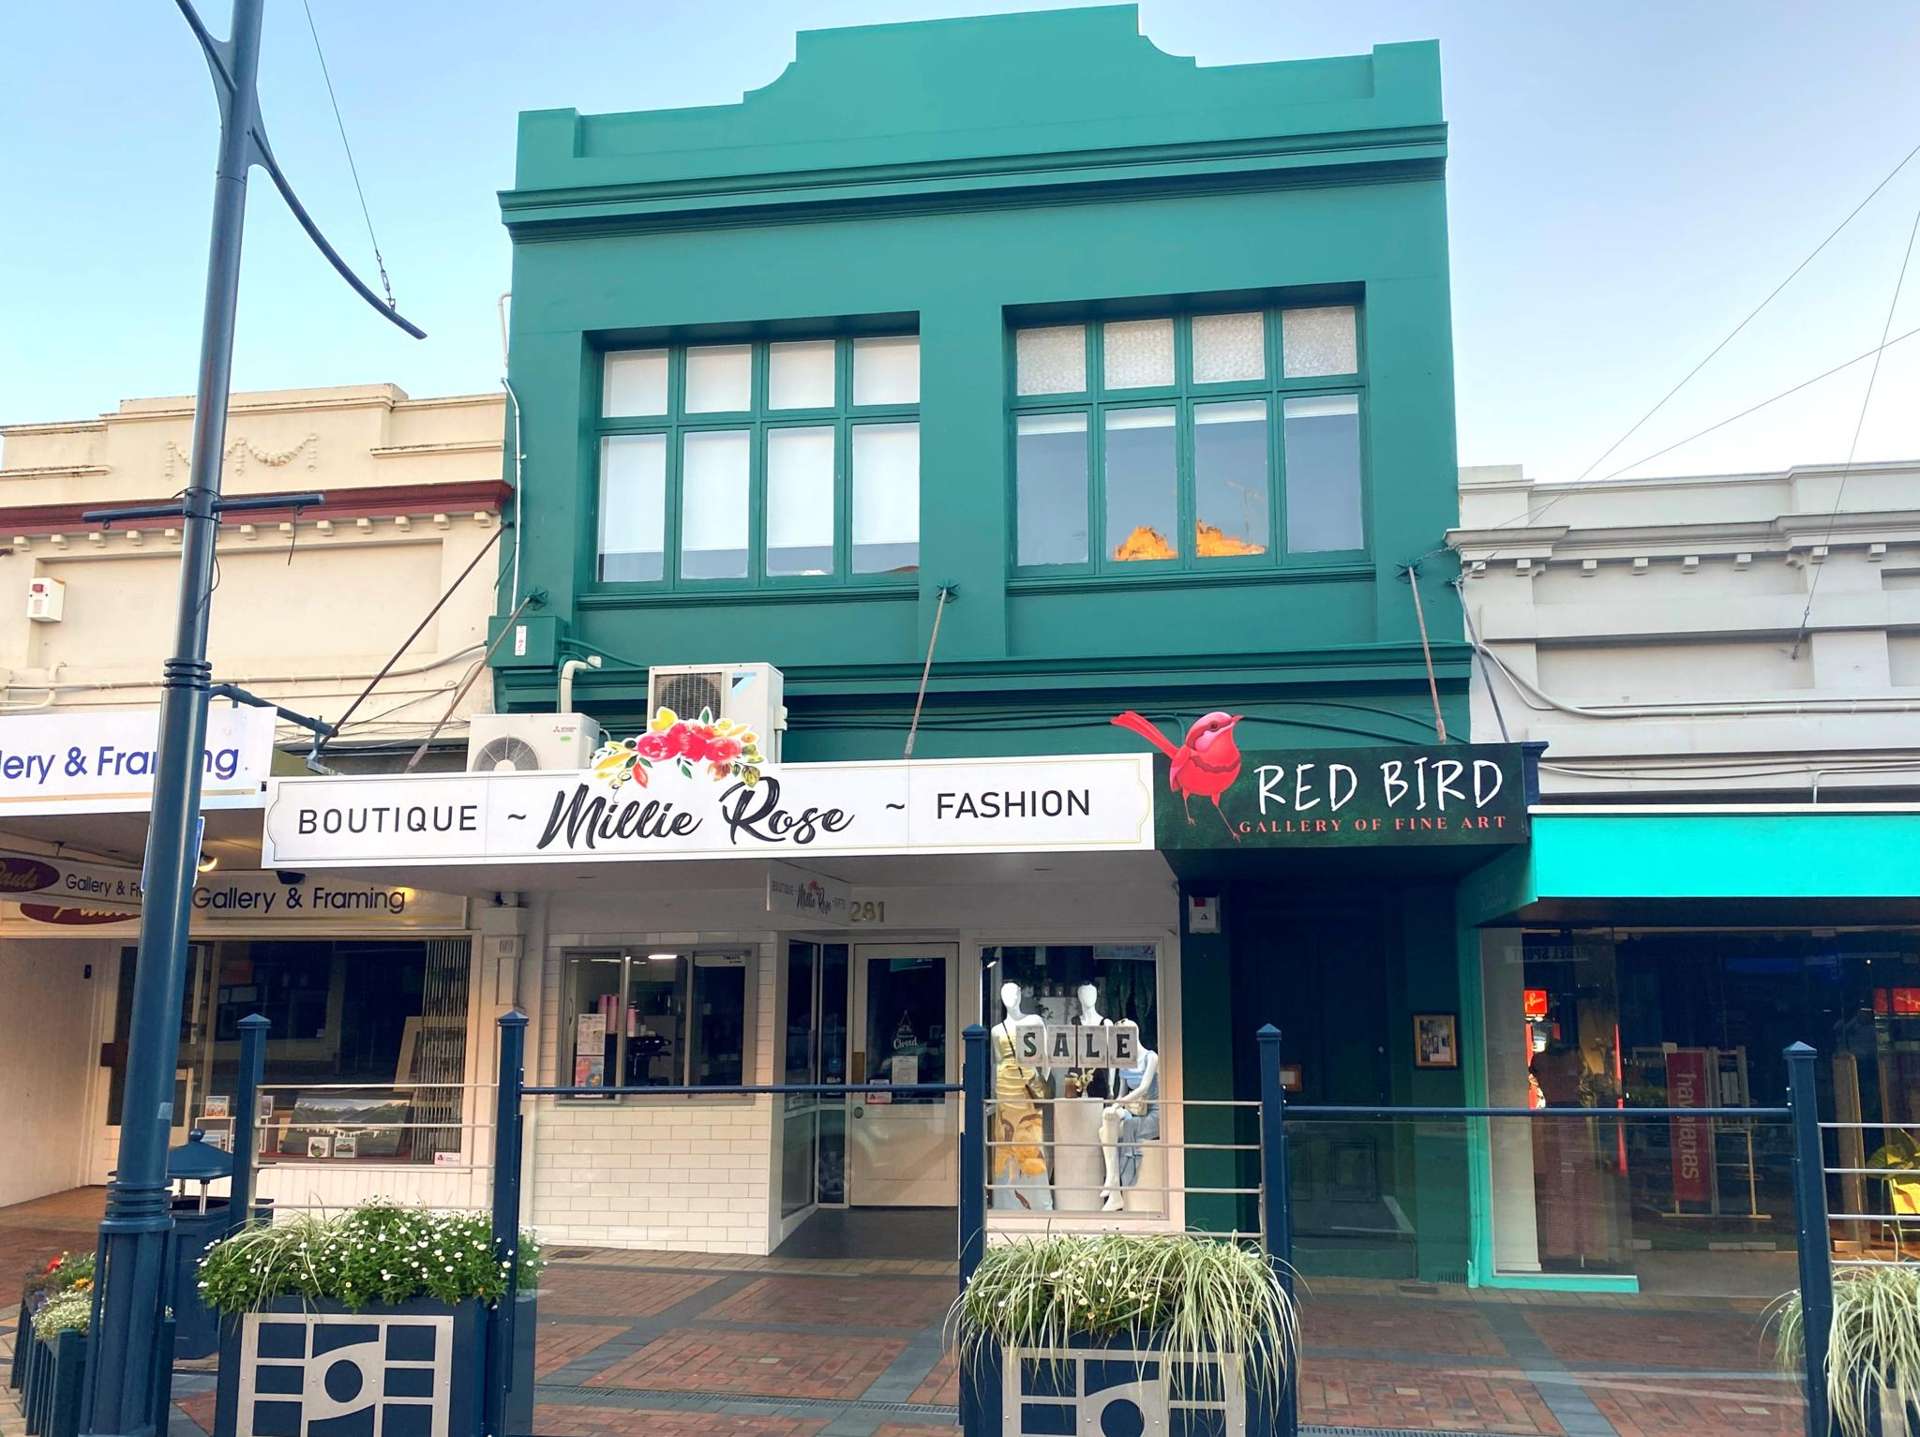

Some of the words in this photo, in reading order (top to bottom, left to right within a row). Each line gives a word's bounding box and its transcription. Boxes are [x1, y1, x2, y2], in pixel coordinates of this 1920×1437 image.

[64, 746, 88, 777] &
[97, 746, 239, 780] Frang
[1254, 763, 1358, 815] RED
[1380, 757, 1503, 811] BIRD
[298, 805, 478, 835] BOUTIQUE
[536, 783, 703, 850] Millie
[718, 776, 855, 845] Rose
[937, 789, 1090, 819] FASHION
[1239, 819, 1343, 833] GALLERY
[1354, 818, 1382, 831] OF
[1395, 816, 1448, 831] FINE
[1461, 815, 1507, 829] ART
[66, 873, 112, 897] Gallery
[116, 880, 126, 896] &
[192, 887, 277, 914] Gallery
[286, 887, 303, 909] &
[313, 887, 405, 914] Framing
[850, 901, 885, 922] 281
[1023, 1032, 1131, 1058] SALE
